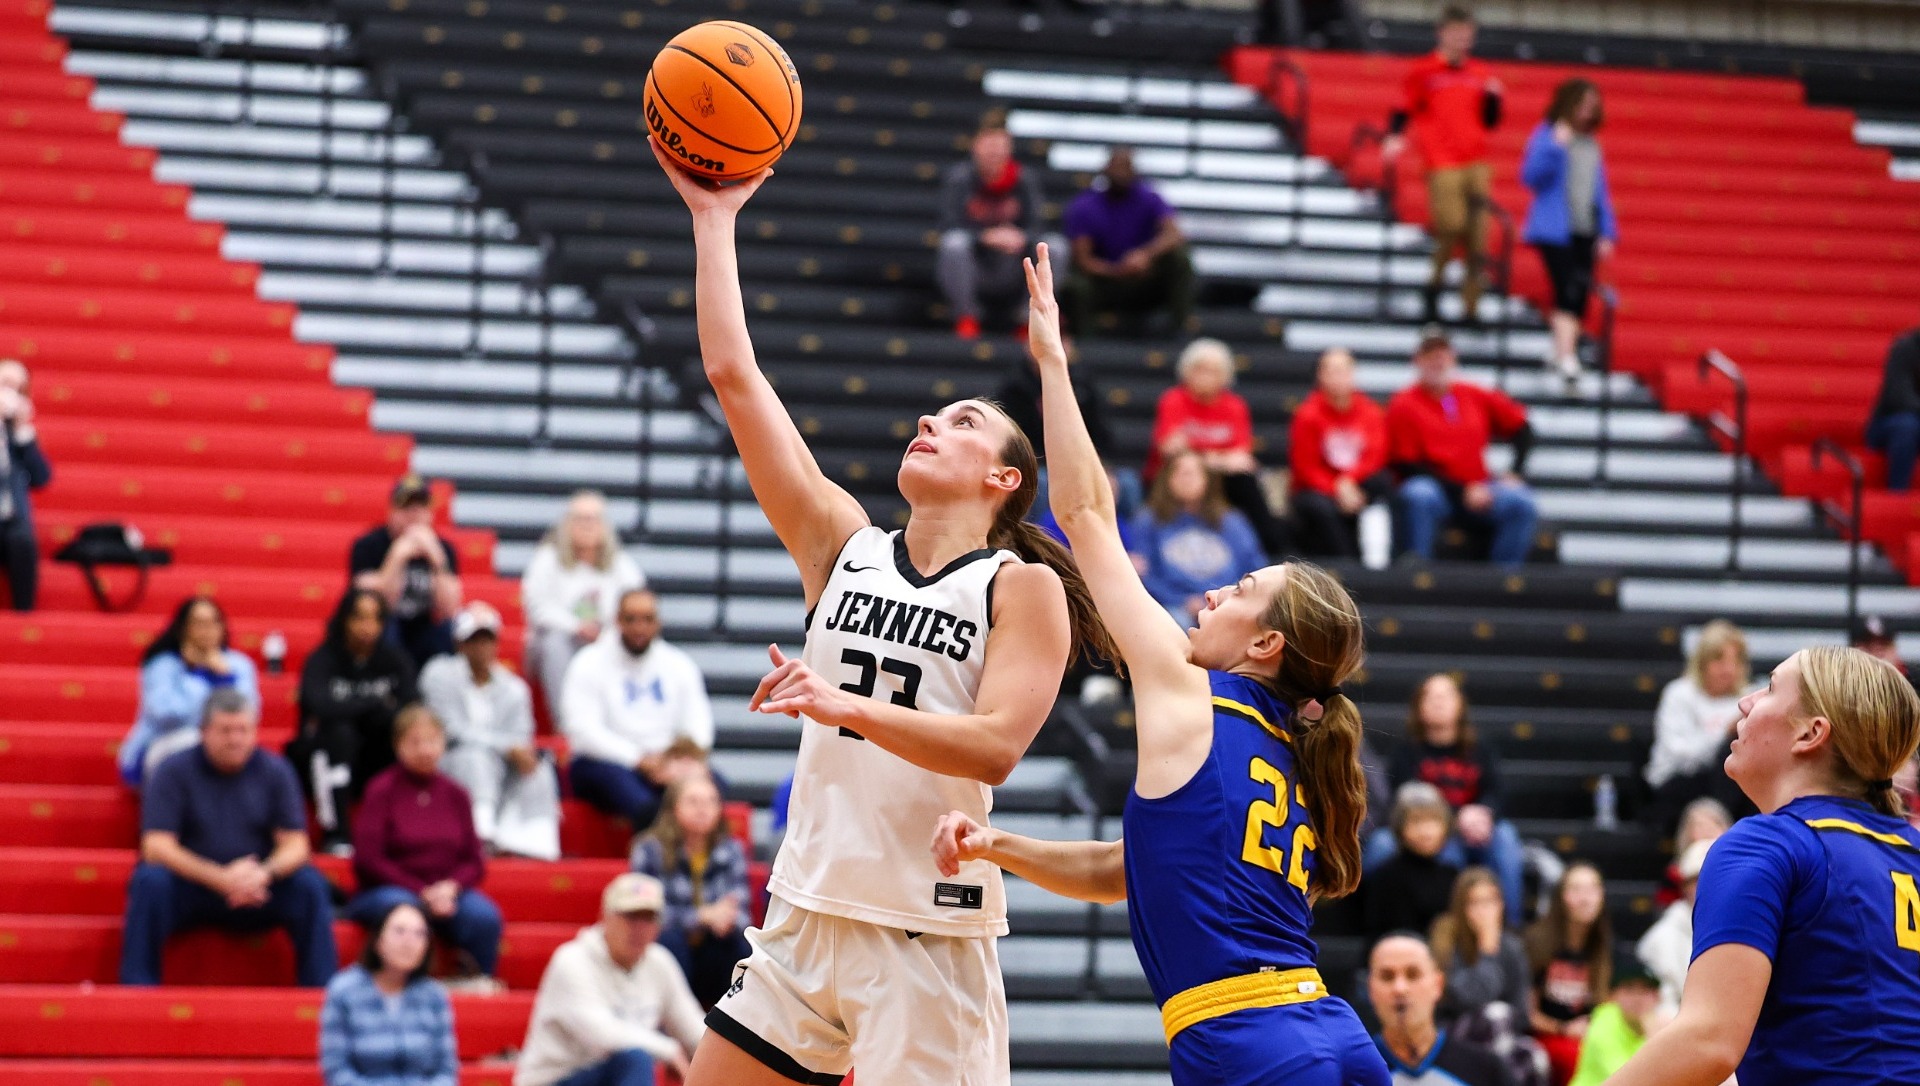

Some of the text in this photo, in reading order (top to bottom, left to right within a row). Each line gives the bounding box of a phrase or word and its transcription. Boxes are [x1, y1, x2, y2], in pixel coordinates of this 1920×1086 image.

[646, 96, 725, 172] Wilson
[826, 590, 978, 662] JENNIES
[967, 892, 974, 902] L
